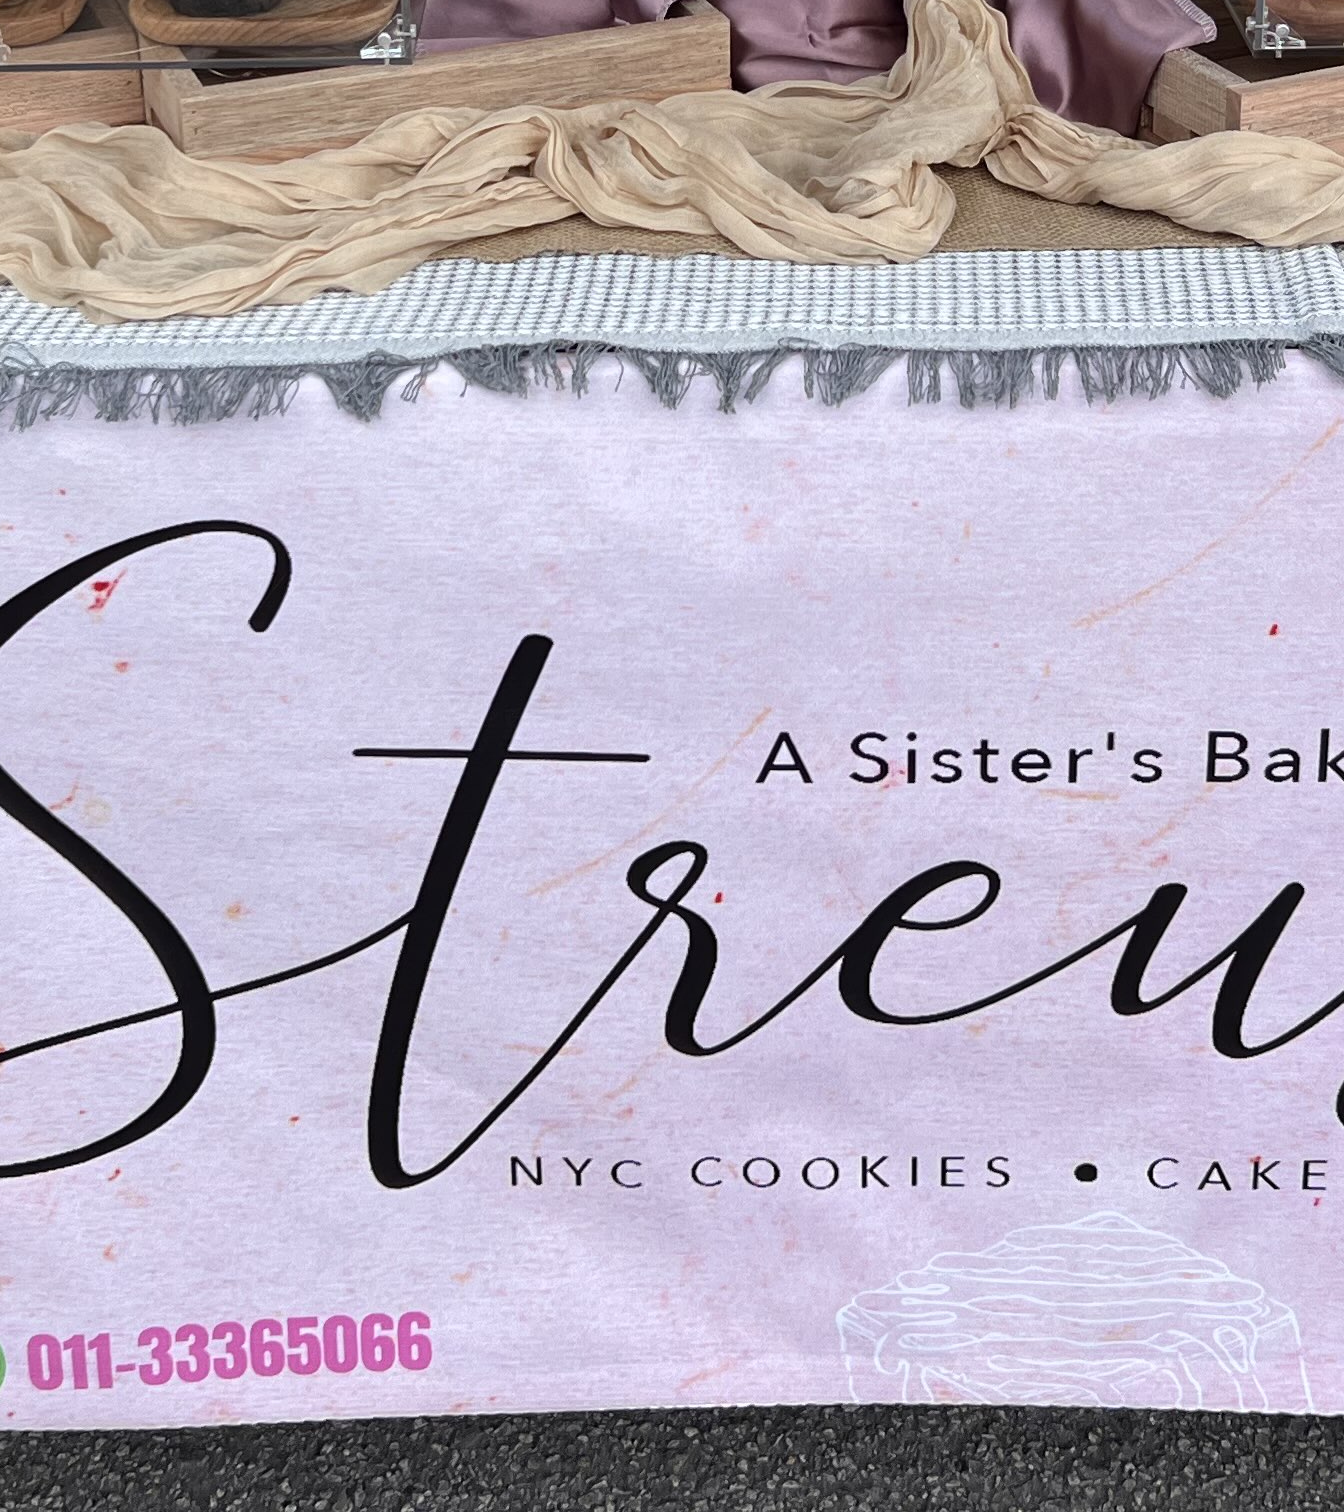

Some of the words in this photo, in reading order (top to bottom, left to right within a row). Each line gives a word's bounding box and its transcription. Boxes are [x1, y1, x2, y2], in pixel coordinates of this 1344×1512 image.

[755, 731, 813, 784] A
[849, 728, 1163, 785] Sister's
[510, 1155, 643, 1190] NYC
[691, 1154, 1013, 1190] COOKIES
[27, 1311, 433, 1392] 011-33365066
